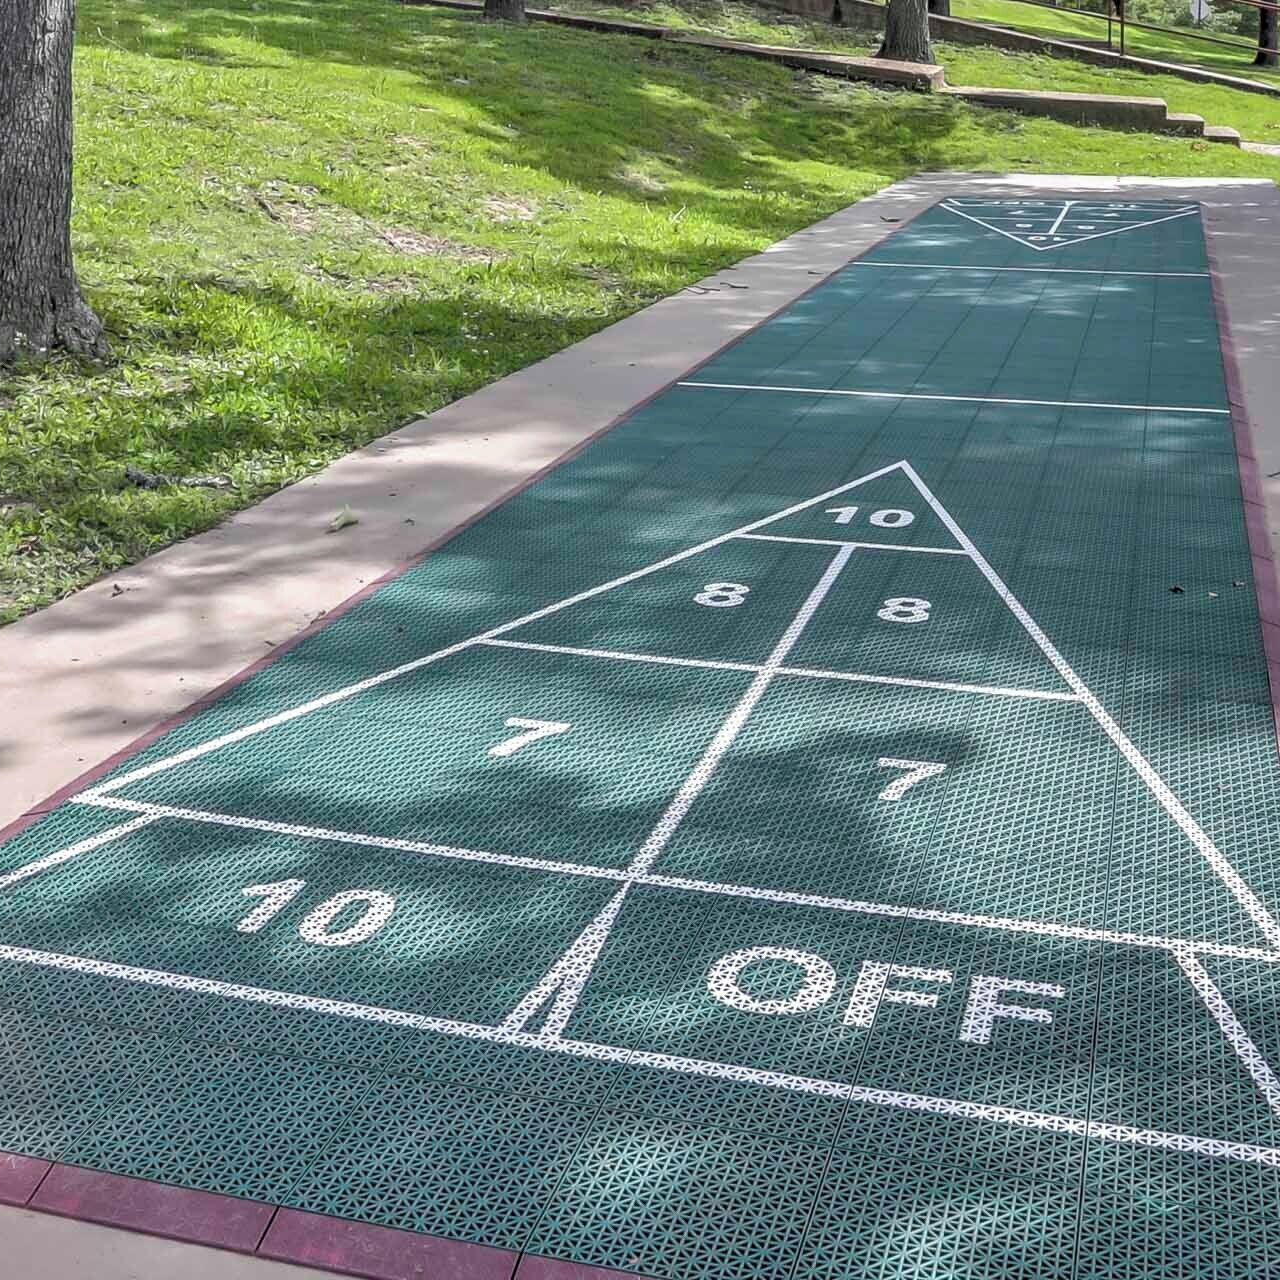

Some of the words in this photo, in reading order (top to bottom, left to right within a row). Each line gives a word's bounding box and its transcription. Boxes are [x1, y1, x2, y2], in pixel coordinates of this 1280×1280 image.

[824, 506, 915, 528] 10
[693, 582, 751, 608] 8
[877, 597, 932, 623] 8
[488, 716, 572, 758] 7
[877, 757, 948, 802] 7
[236, 877, 396, 947] 10
[706, 945, 1067, 1046] OFF
